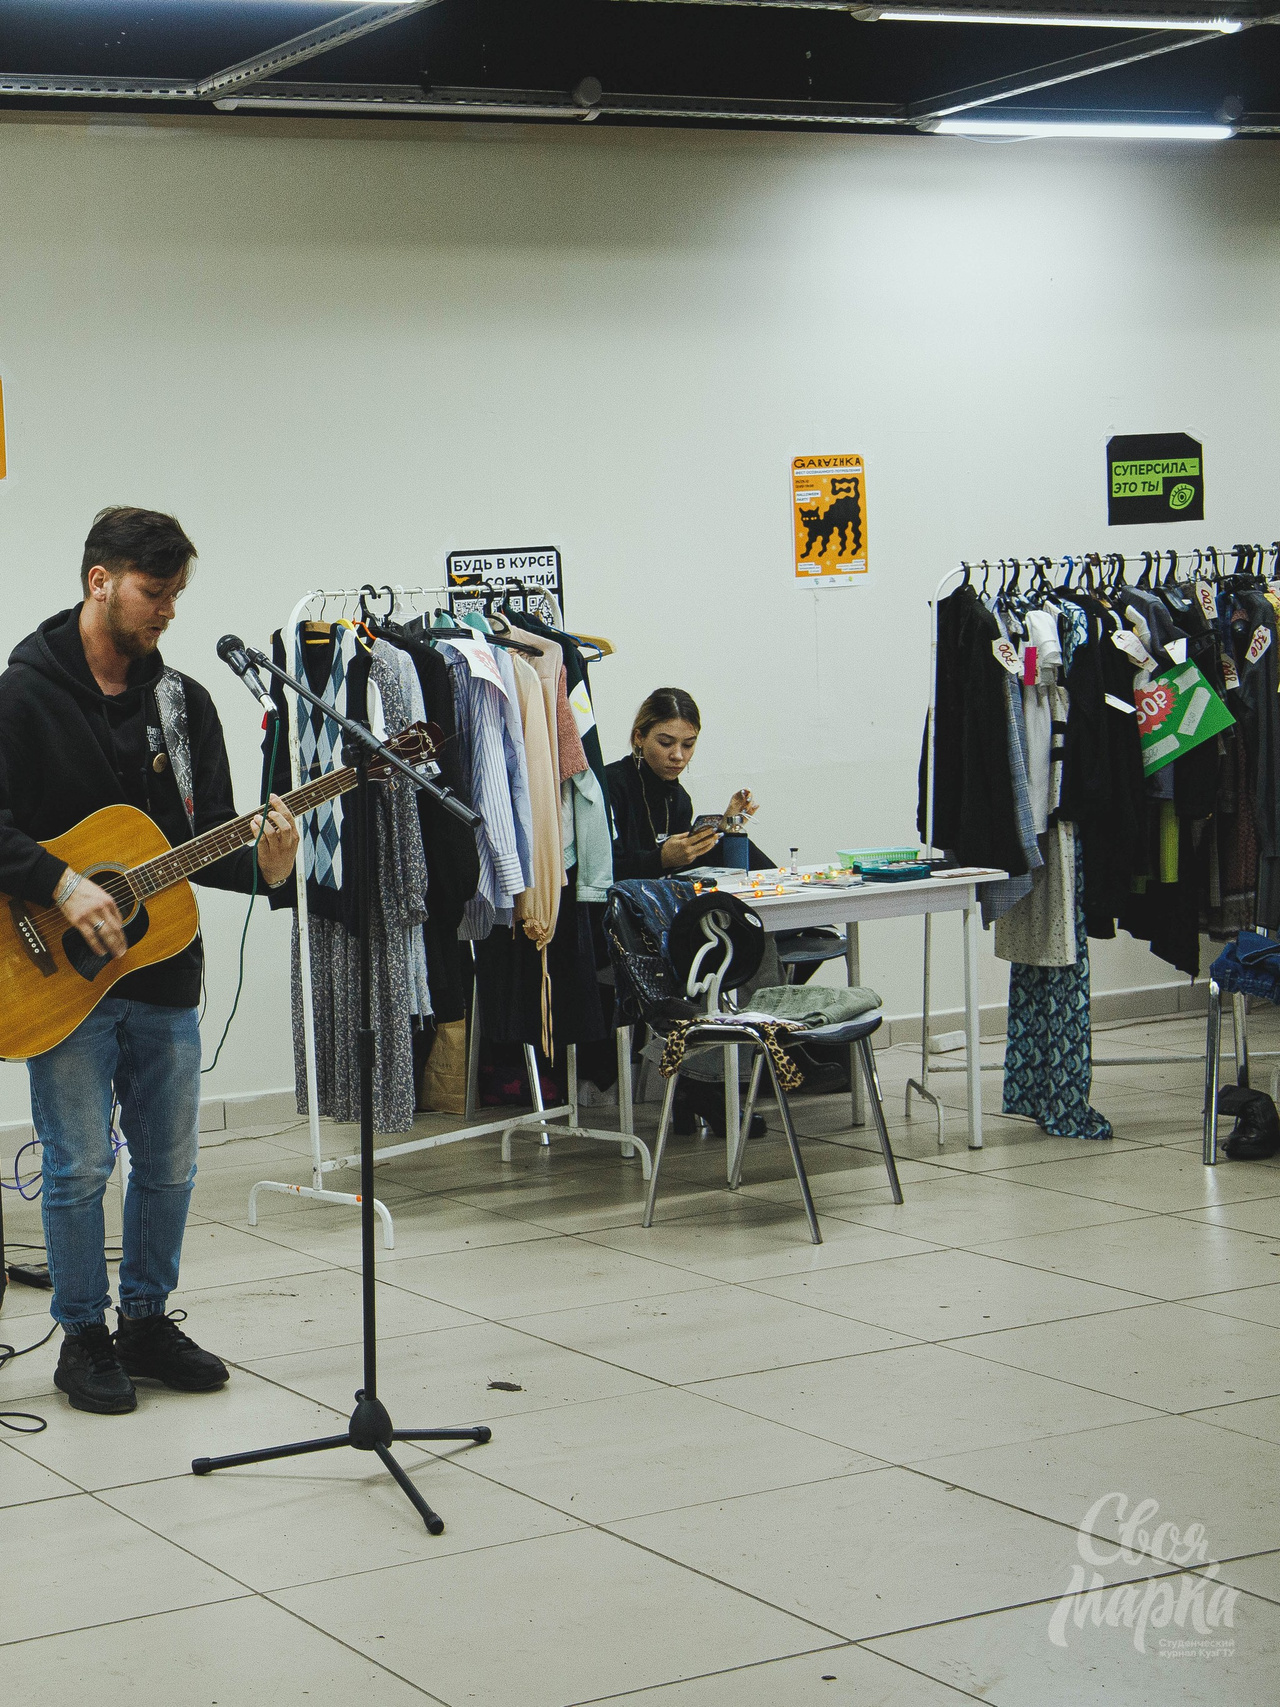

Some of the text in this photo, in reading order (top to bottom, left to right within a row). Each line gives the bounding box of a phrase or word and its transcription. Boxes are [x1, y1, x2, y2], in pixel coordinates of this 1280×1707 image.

[1113, 461, 1188, 476] СУПЕРСИЛА
[1113, 480, 1160, 494] ЭТО ТЫ
[453, 555, 555, 573] БУДЬ В КУРСЕ
[1201, 589, 1214, 612] 500
[999, 644, 1017, 667] 700
